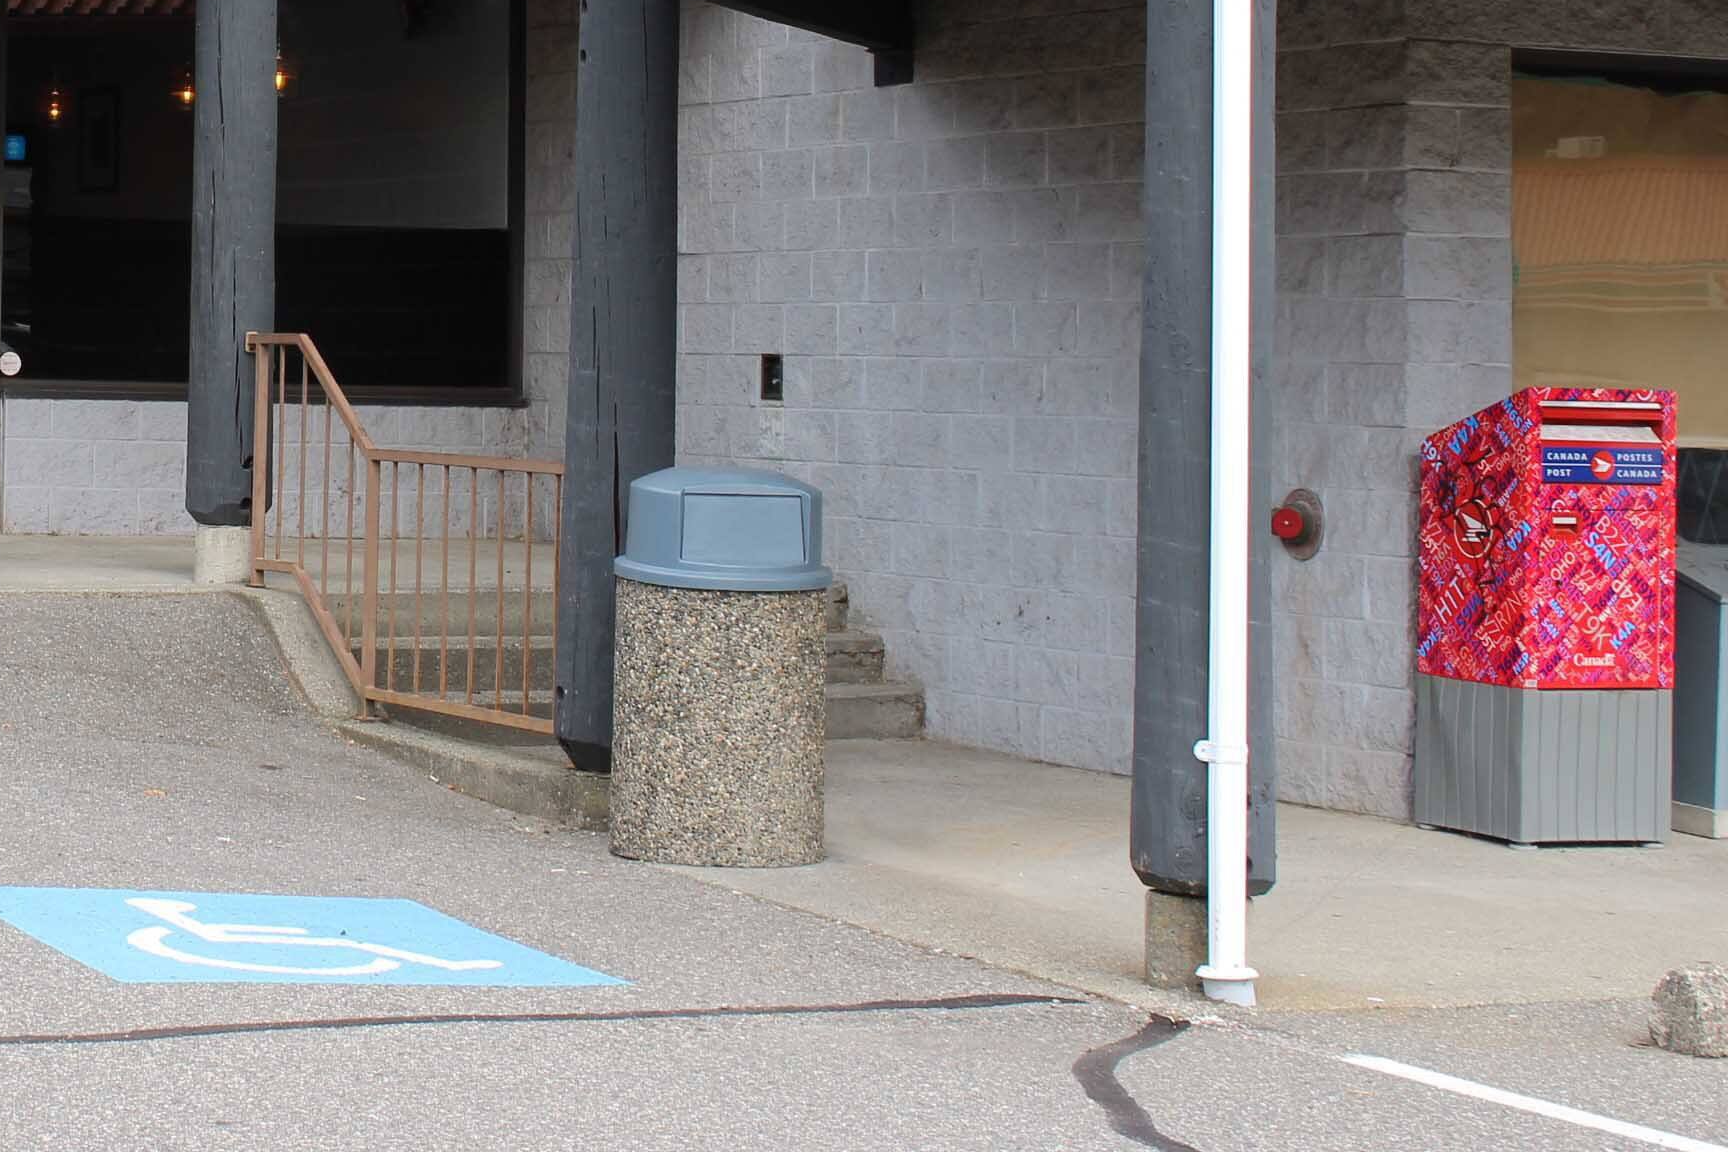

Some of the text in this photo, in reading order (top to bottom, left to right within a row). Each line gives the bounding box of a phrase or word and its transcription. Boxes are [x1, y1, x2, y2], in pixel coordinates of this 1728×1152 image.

[1546, 452, 1588, 462] CANADA
[1616, 453, 1653, 462] POSTES
[1546, 469, 1572, 477] POST
[1616, 469, 1657, 479] CANADA
[1573, 652, 1616, 667] Canada
